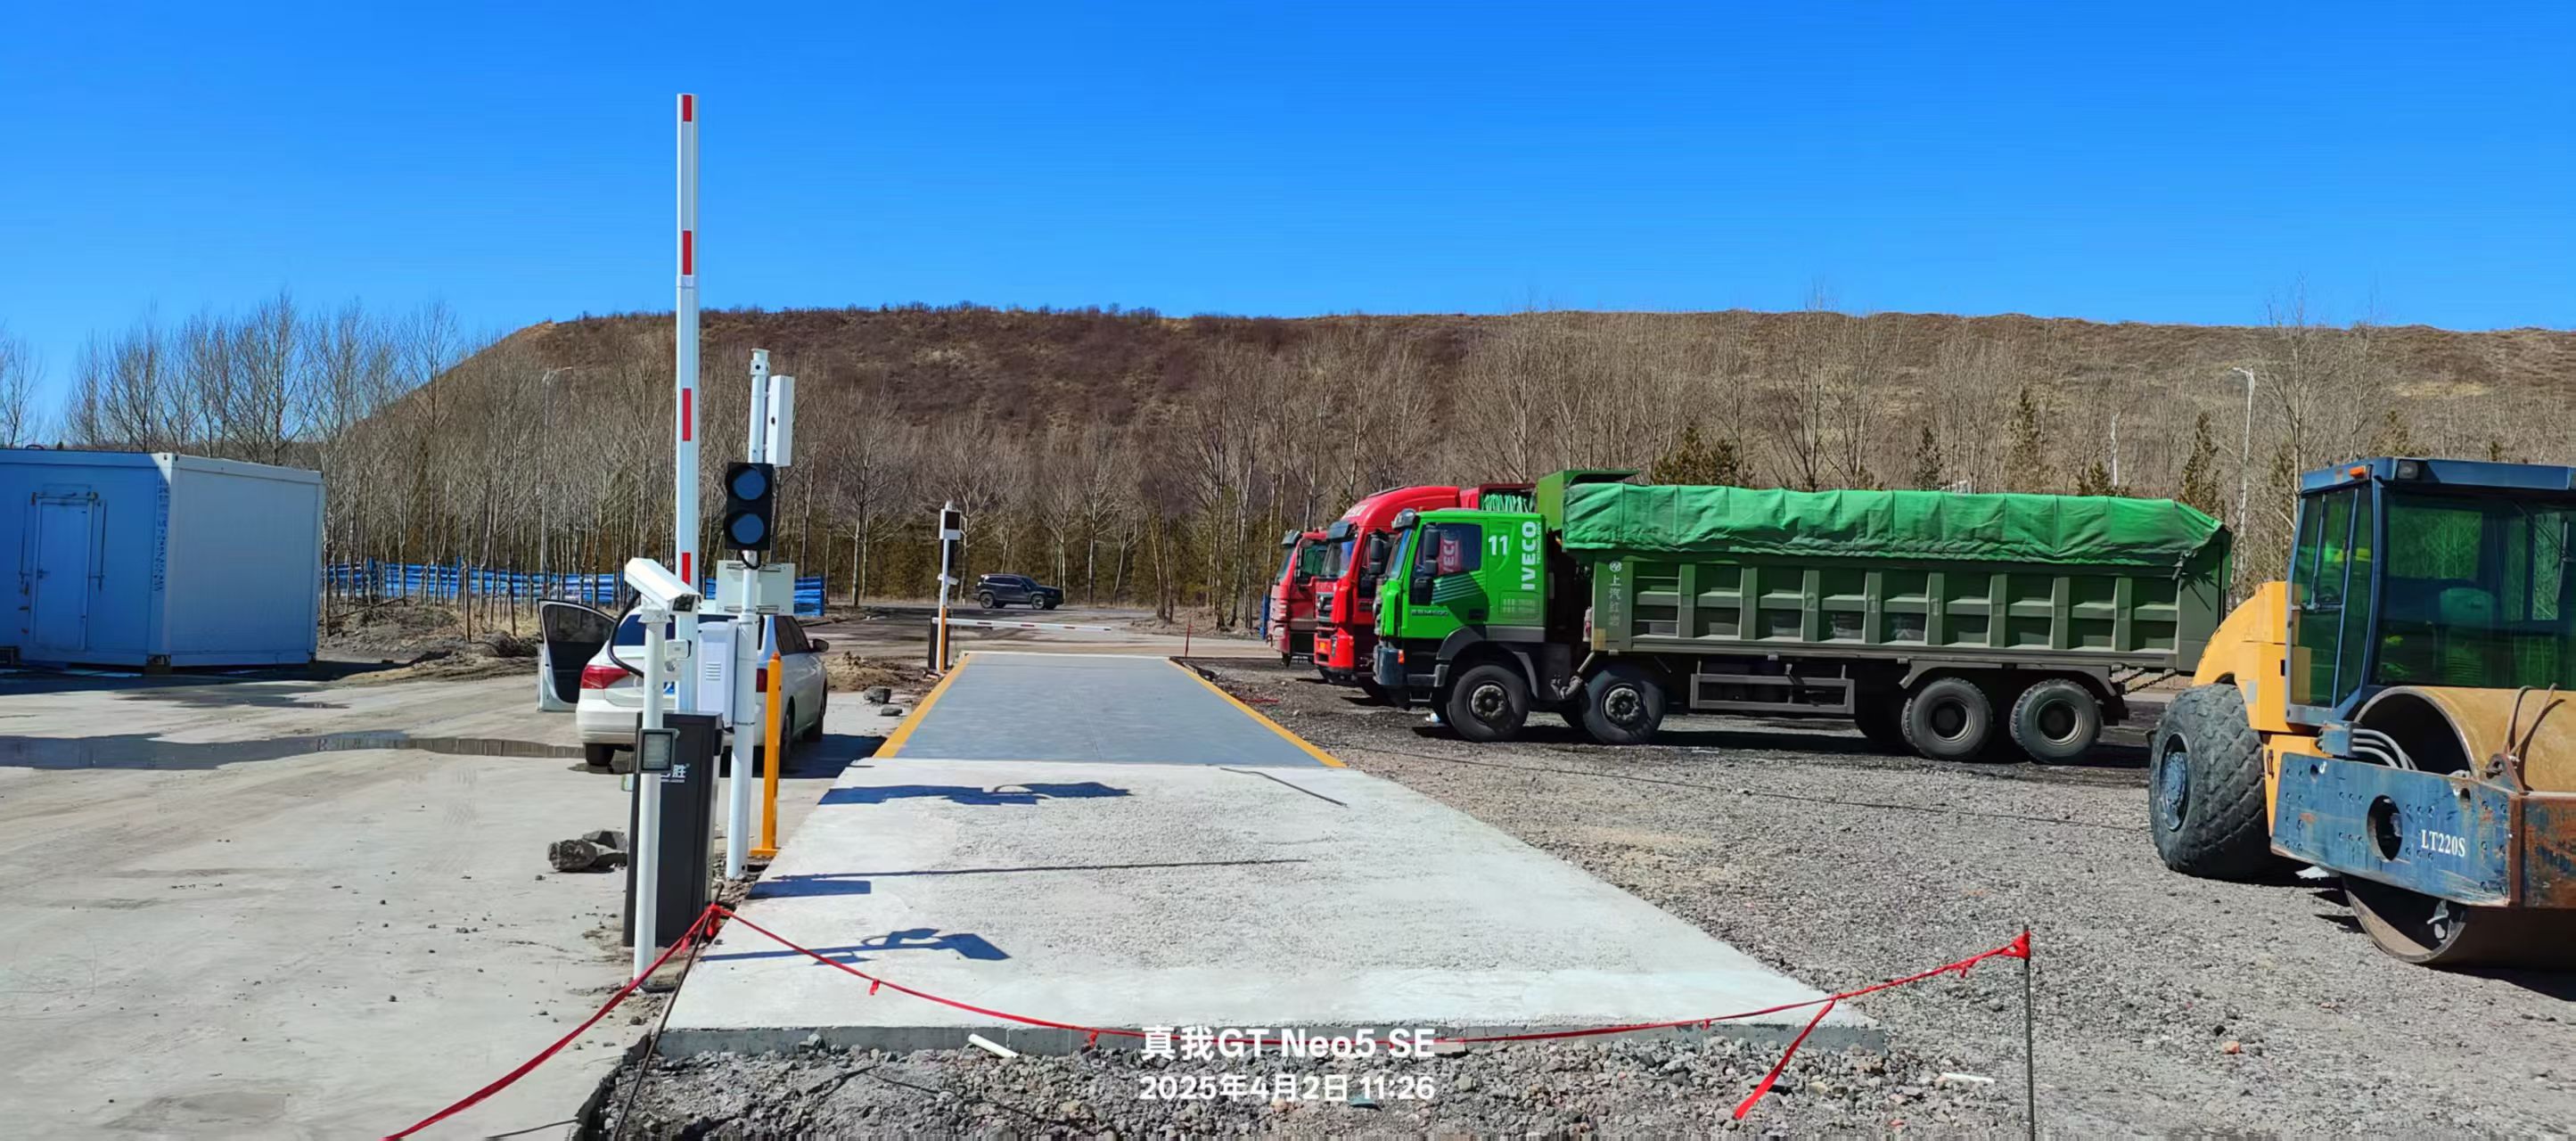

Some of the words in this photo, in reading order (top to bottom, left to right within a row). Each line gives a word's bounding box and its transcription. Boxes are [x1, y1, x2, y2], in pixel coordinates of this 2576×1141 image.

[1488, 535, 1508, 556] 11
[1521, 521, 1537, 590] IVECO
[2421, 829, 2465, 858] LT220S
